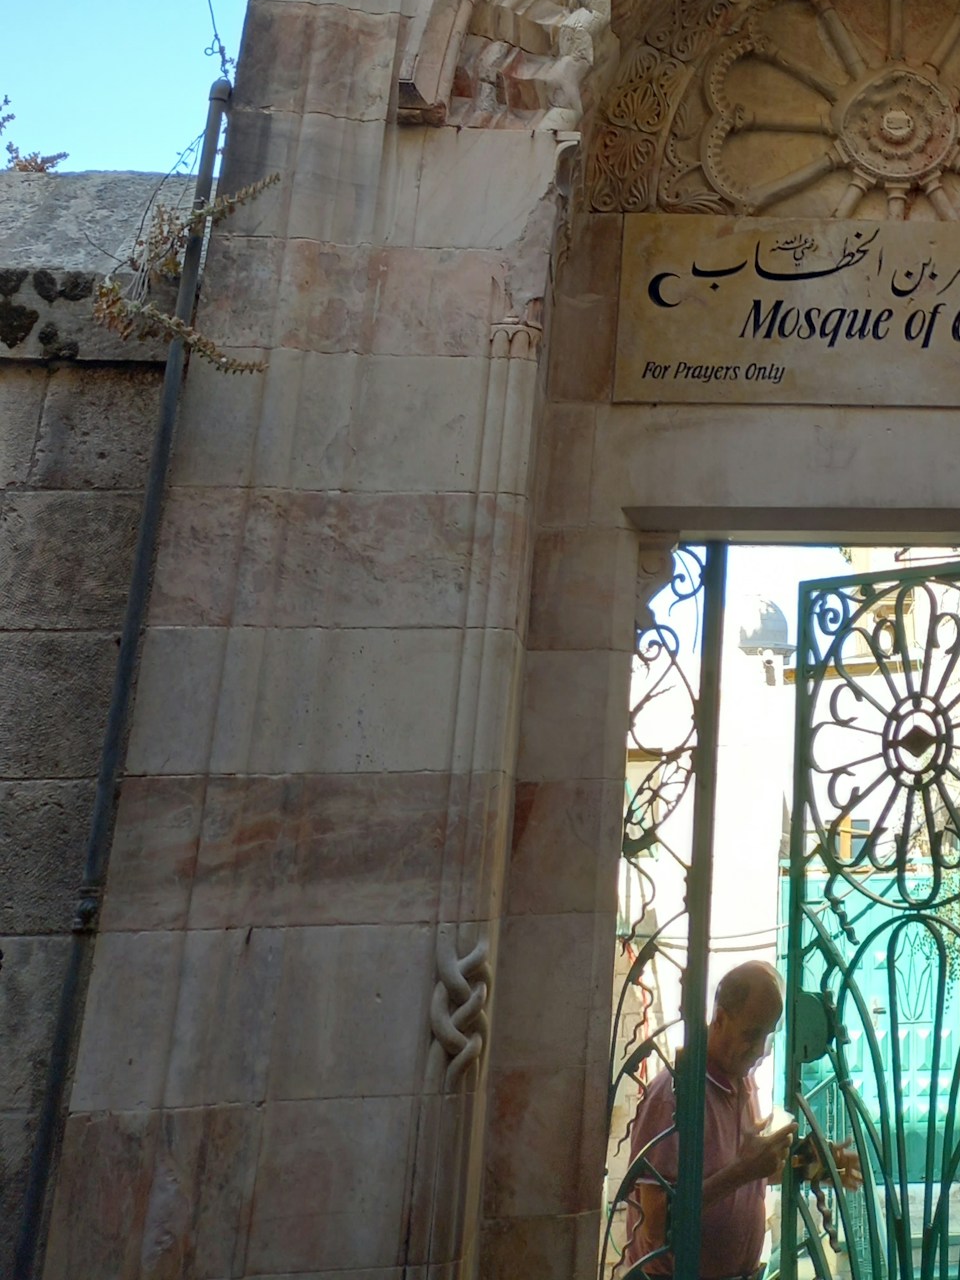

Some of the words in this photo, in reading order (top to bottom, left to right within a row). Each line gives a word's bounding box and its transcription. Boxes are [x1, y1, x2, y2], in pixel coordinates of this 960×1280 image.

[691, 227, 885, 292] الخطاب
[891, 256, 938, 297] بن
[739, 299, 894, 348] Mosque
[904, 302, 947, 348] of
[642, 361, 671, 379] For
[674, 361, 741, 383] Prayers
[745, 363, 785, 384] Only
